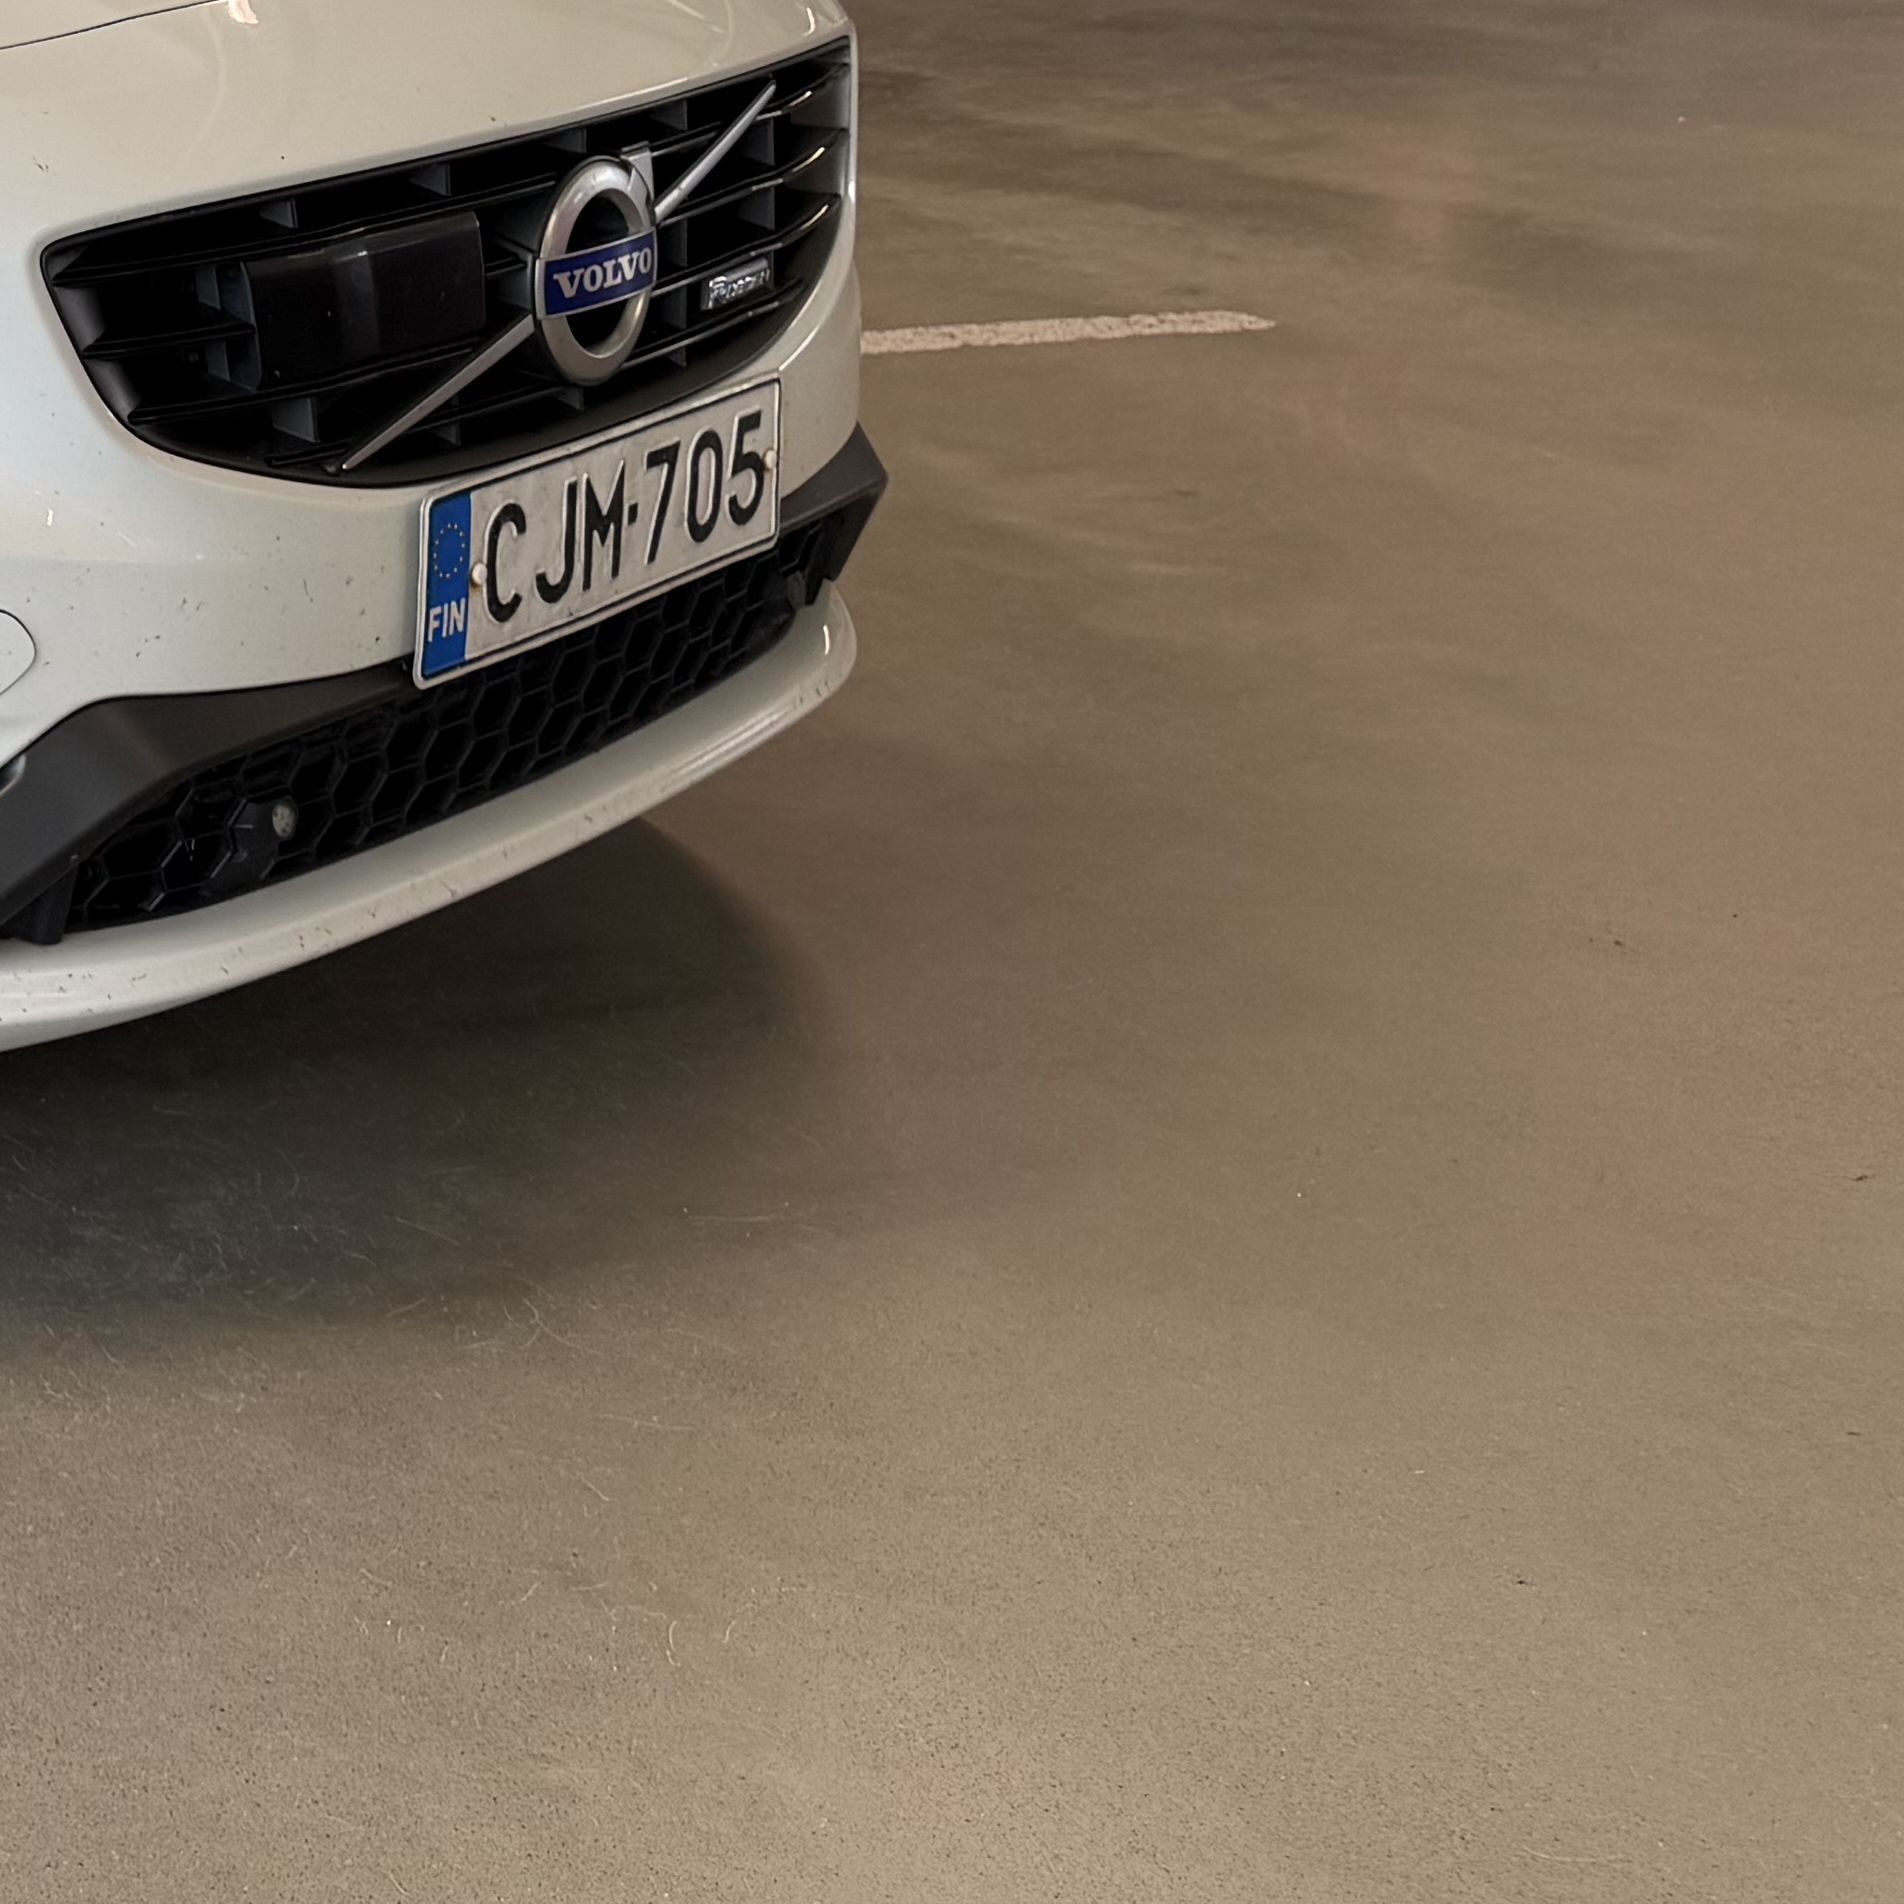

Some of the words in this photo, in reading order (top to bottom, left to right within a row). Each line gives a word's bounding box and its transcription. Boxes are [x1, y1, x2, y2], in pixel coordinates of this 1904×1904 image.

[553, 247, 652, 299] VOLVO
[427, 597, 466, 644] FIN
[483, 405, 766, 624] CJM-705
